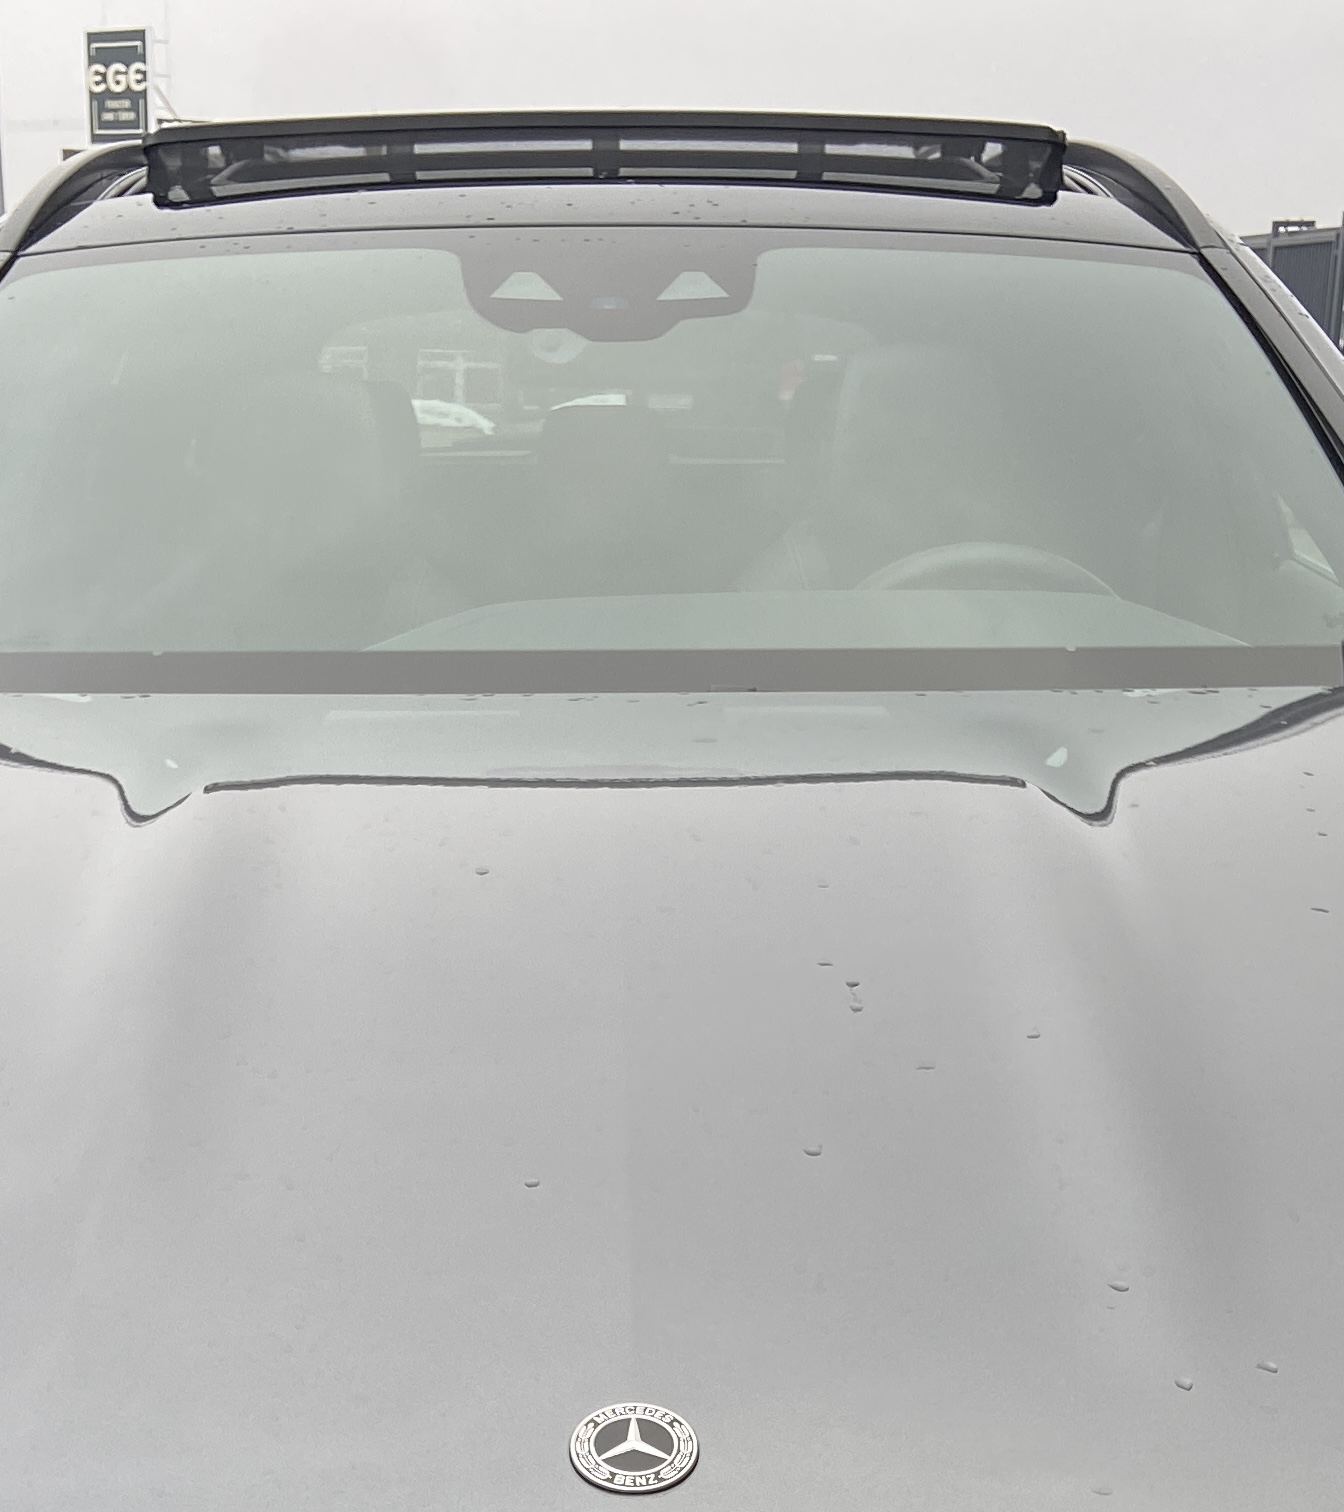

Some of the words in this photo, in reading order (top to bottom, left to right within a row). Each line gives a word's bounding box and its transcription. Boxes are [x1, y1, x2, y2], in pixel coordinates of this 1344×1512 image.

[88, 62, 147, 93] EGE
[592, 1406, 674, 1424] MERCEDES
[613, 1474, 658, 1487] BENZ
